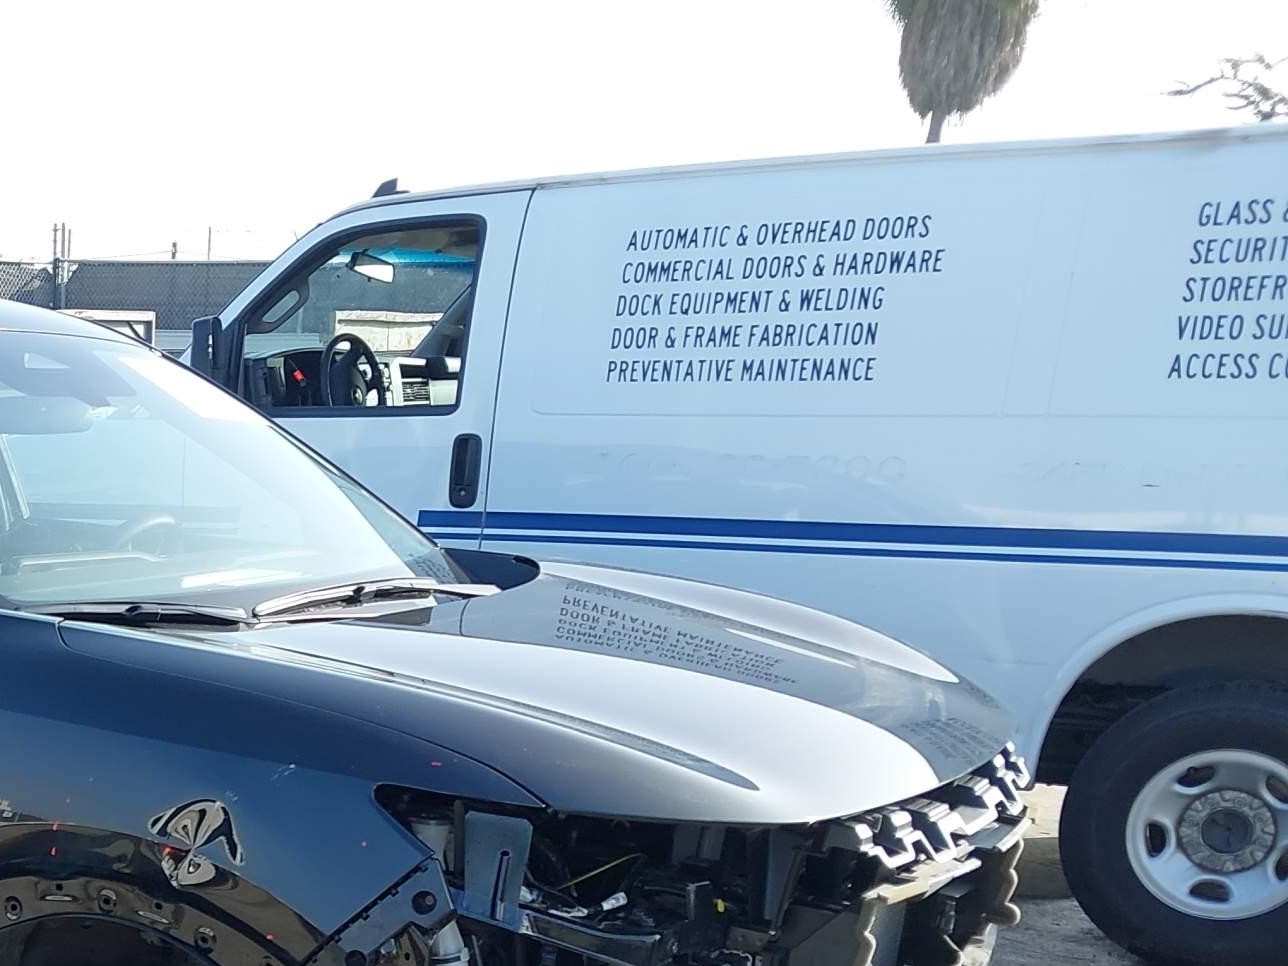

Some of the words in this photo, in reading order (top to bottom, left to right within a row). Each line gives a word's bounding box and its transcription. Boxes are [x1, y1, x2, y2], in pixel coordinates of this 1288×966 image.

[1198, 198, 1275, 228] GLASS
[626, 226, 731, 252] AUTOMATIC
[736, 224, 749, 247] &
[756, 218, 856, 246] OVERHEAD
[862, 214, 933, 241] DOORS
[622, 258, 735, 285] COMMERCIAL
[742, 254, 808, 280] DOORS
[812, 253, 826, 278] &
[832, 248, 946, 277] HARDWARE
[616, 293, 663, 317] DOCK
[668, 289, 774, 316] EQUIPMENT
[778, 289, 792, 313] &
[799, 286, 886, 313] WELDING
[1181, 274, 1288, 303] STOREFR
[611, 326, 659, 350] DOOR
[664, 325, 677, 349] &
[682, 324, 743, 349] FRAME
[748, 321, 878, 348] FABRICATION
[1178, 314, 1245, 341] VIDEO
[1252, 313, 1288, 340] SU
[606, 359, 735, 383] PREVENTATIVE
[740, 357, 877, 383] MAINTENANCE
[1167, 352, 1261, 380] ACCESS
